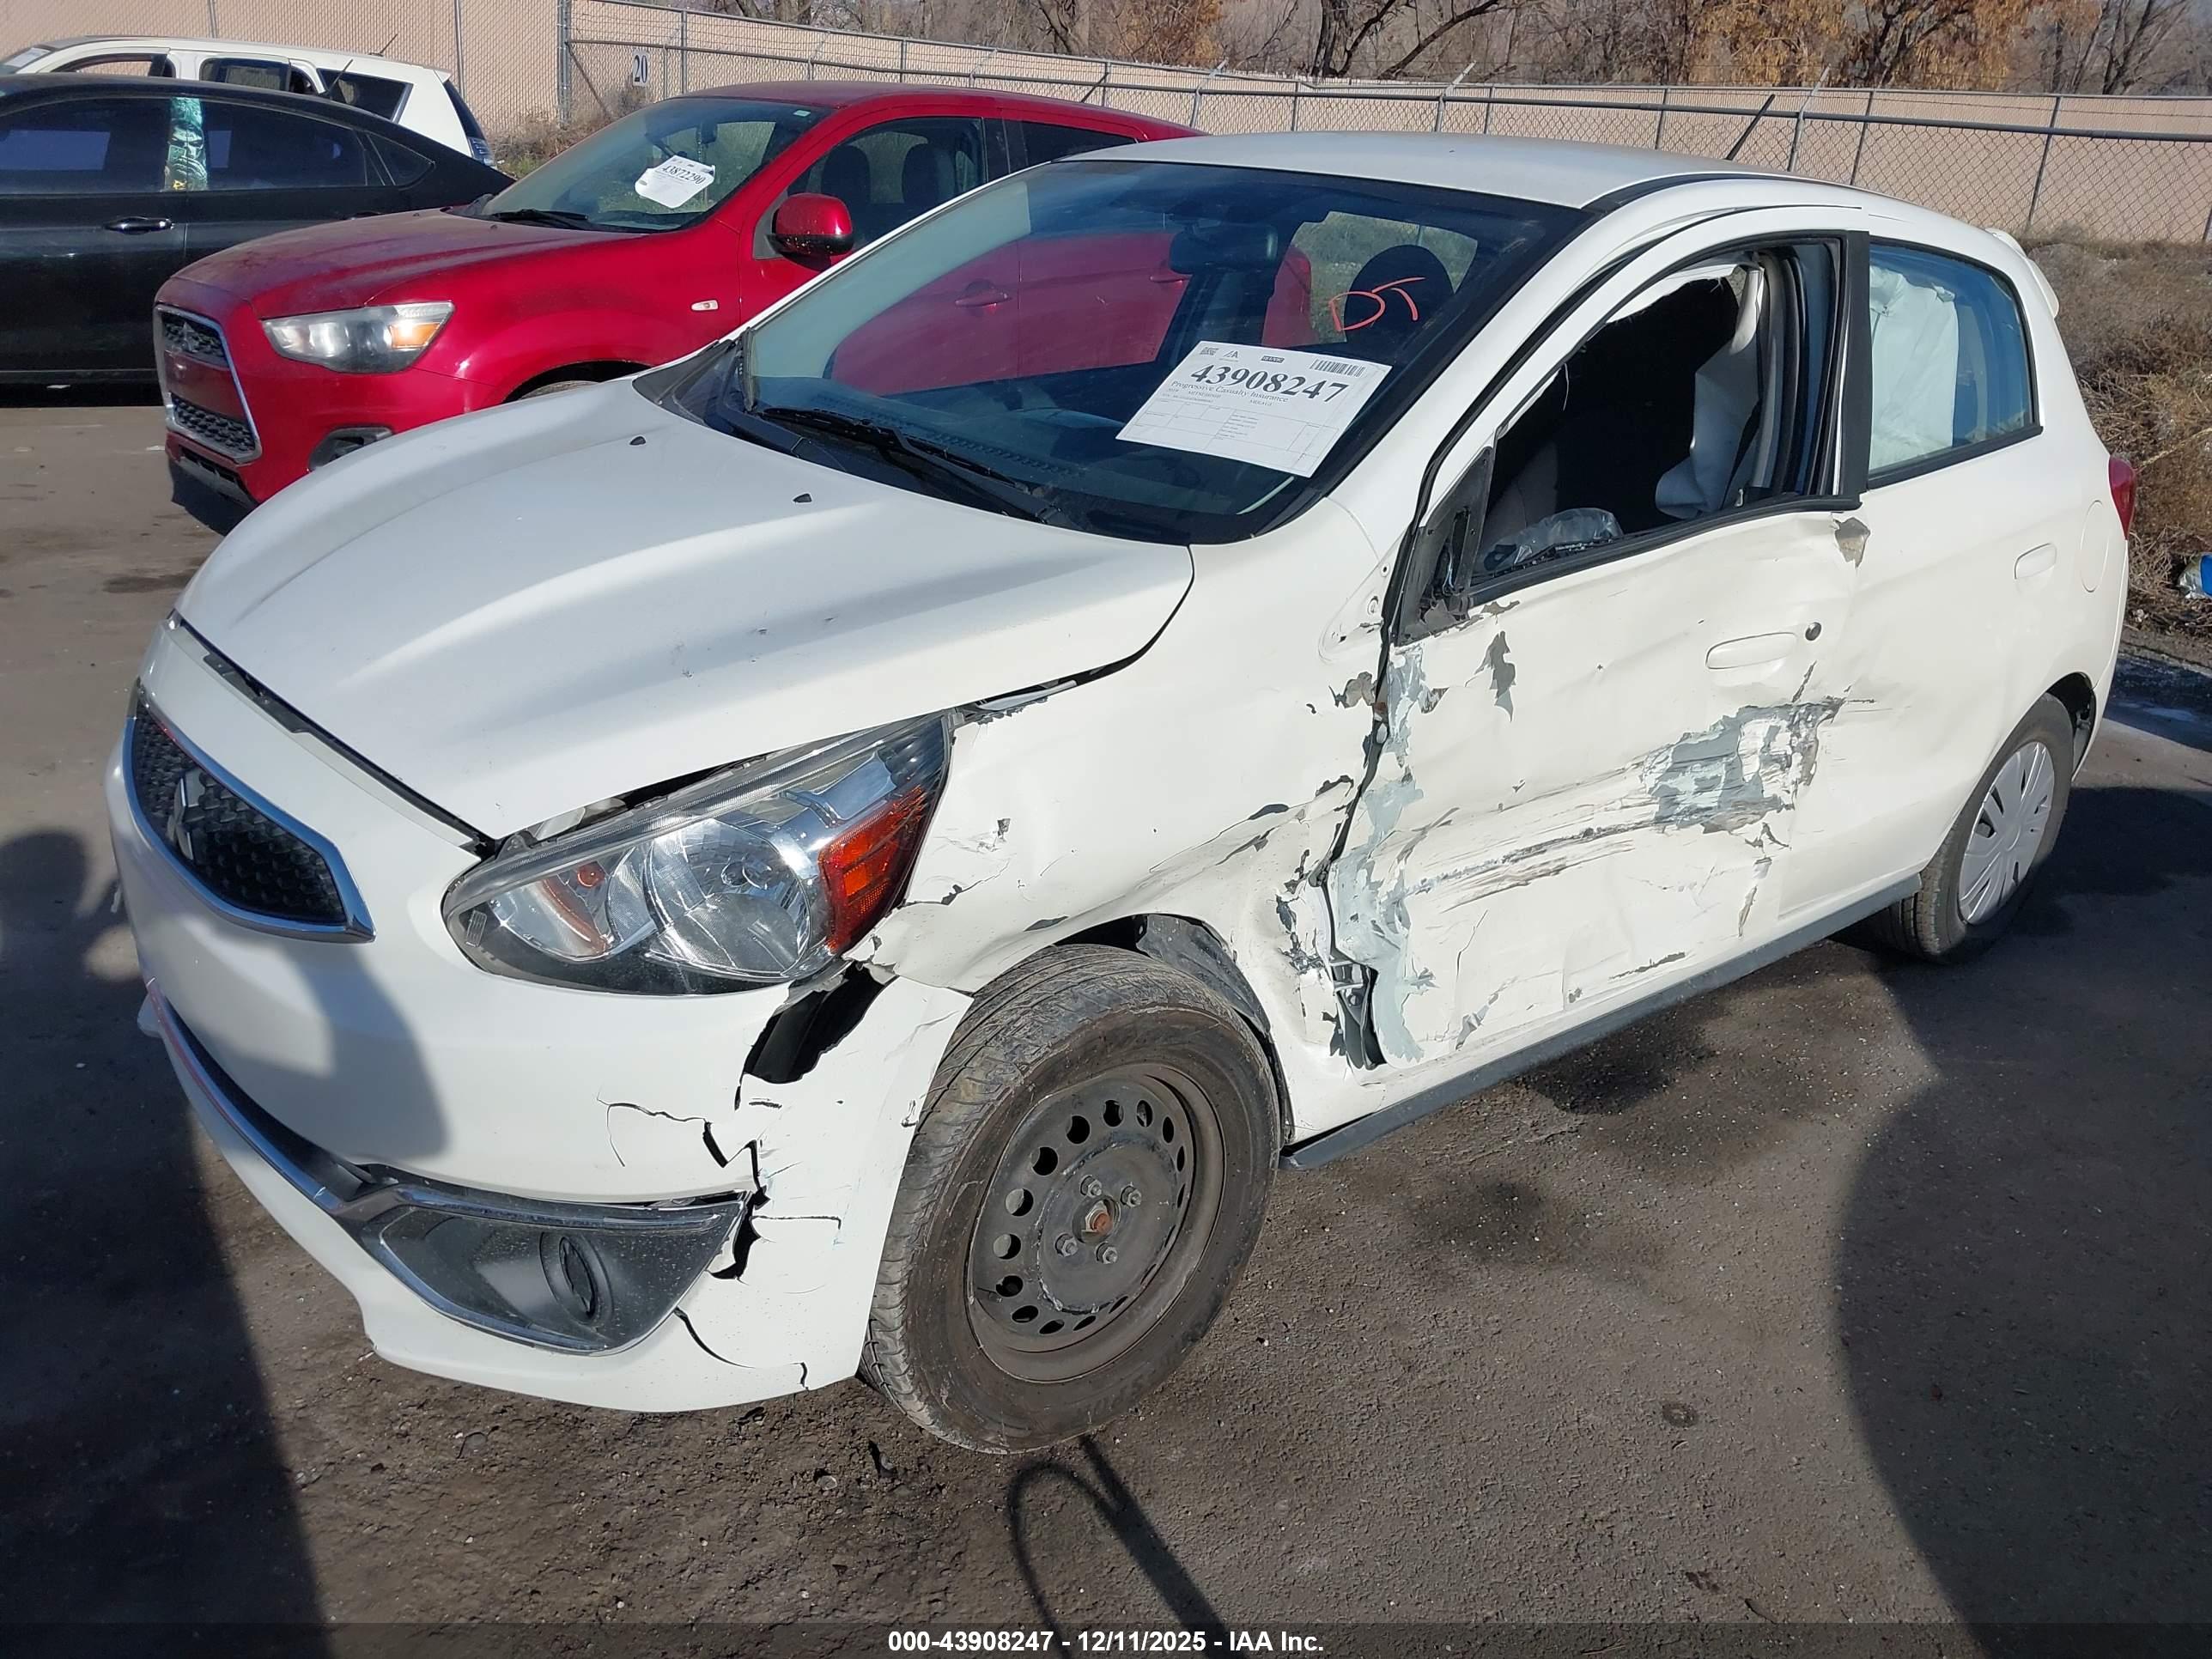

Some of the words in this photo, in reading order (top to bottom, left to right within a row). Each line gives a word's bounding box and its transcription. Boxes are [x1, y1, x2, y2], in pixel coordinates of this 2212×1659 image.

[634, 55, 648, 83] 20
[1170, 380, 1214, 392] Progressive
[1216, 386, 1248, 398] Casualty
[1250, 392, 1289, 403] Insurance
[1190, 364, 1349, 403] 43908247
